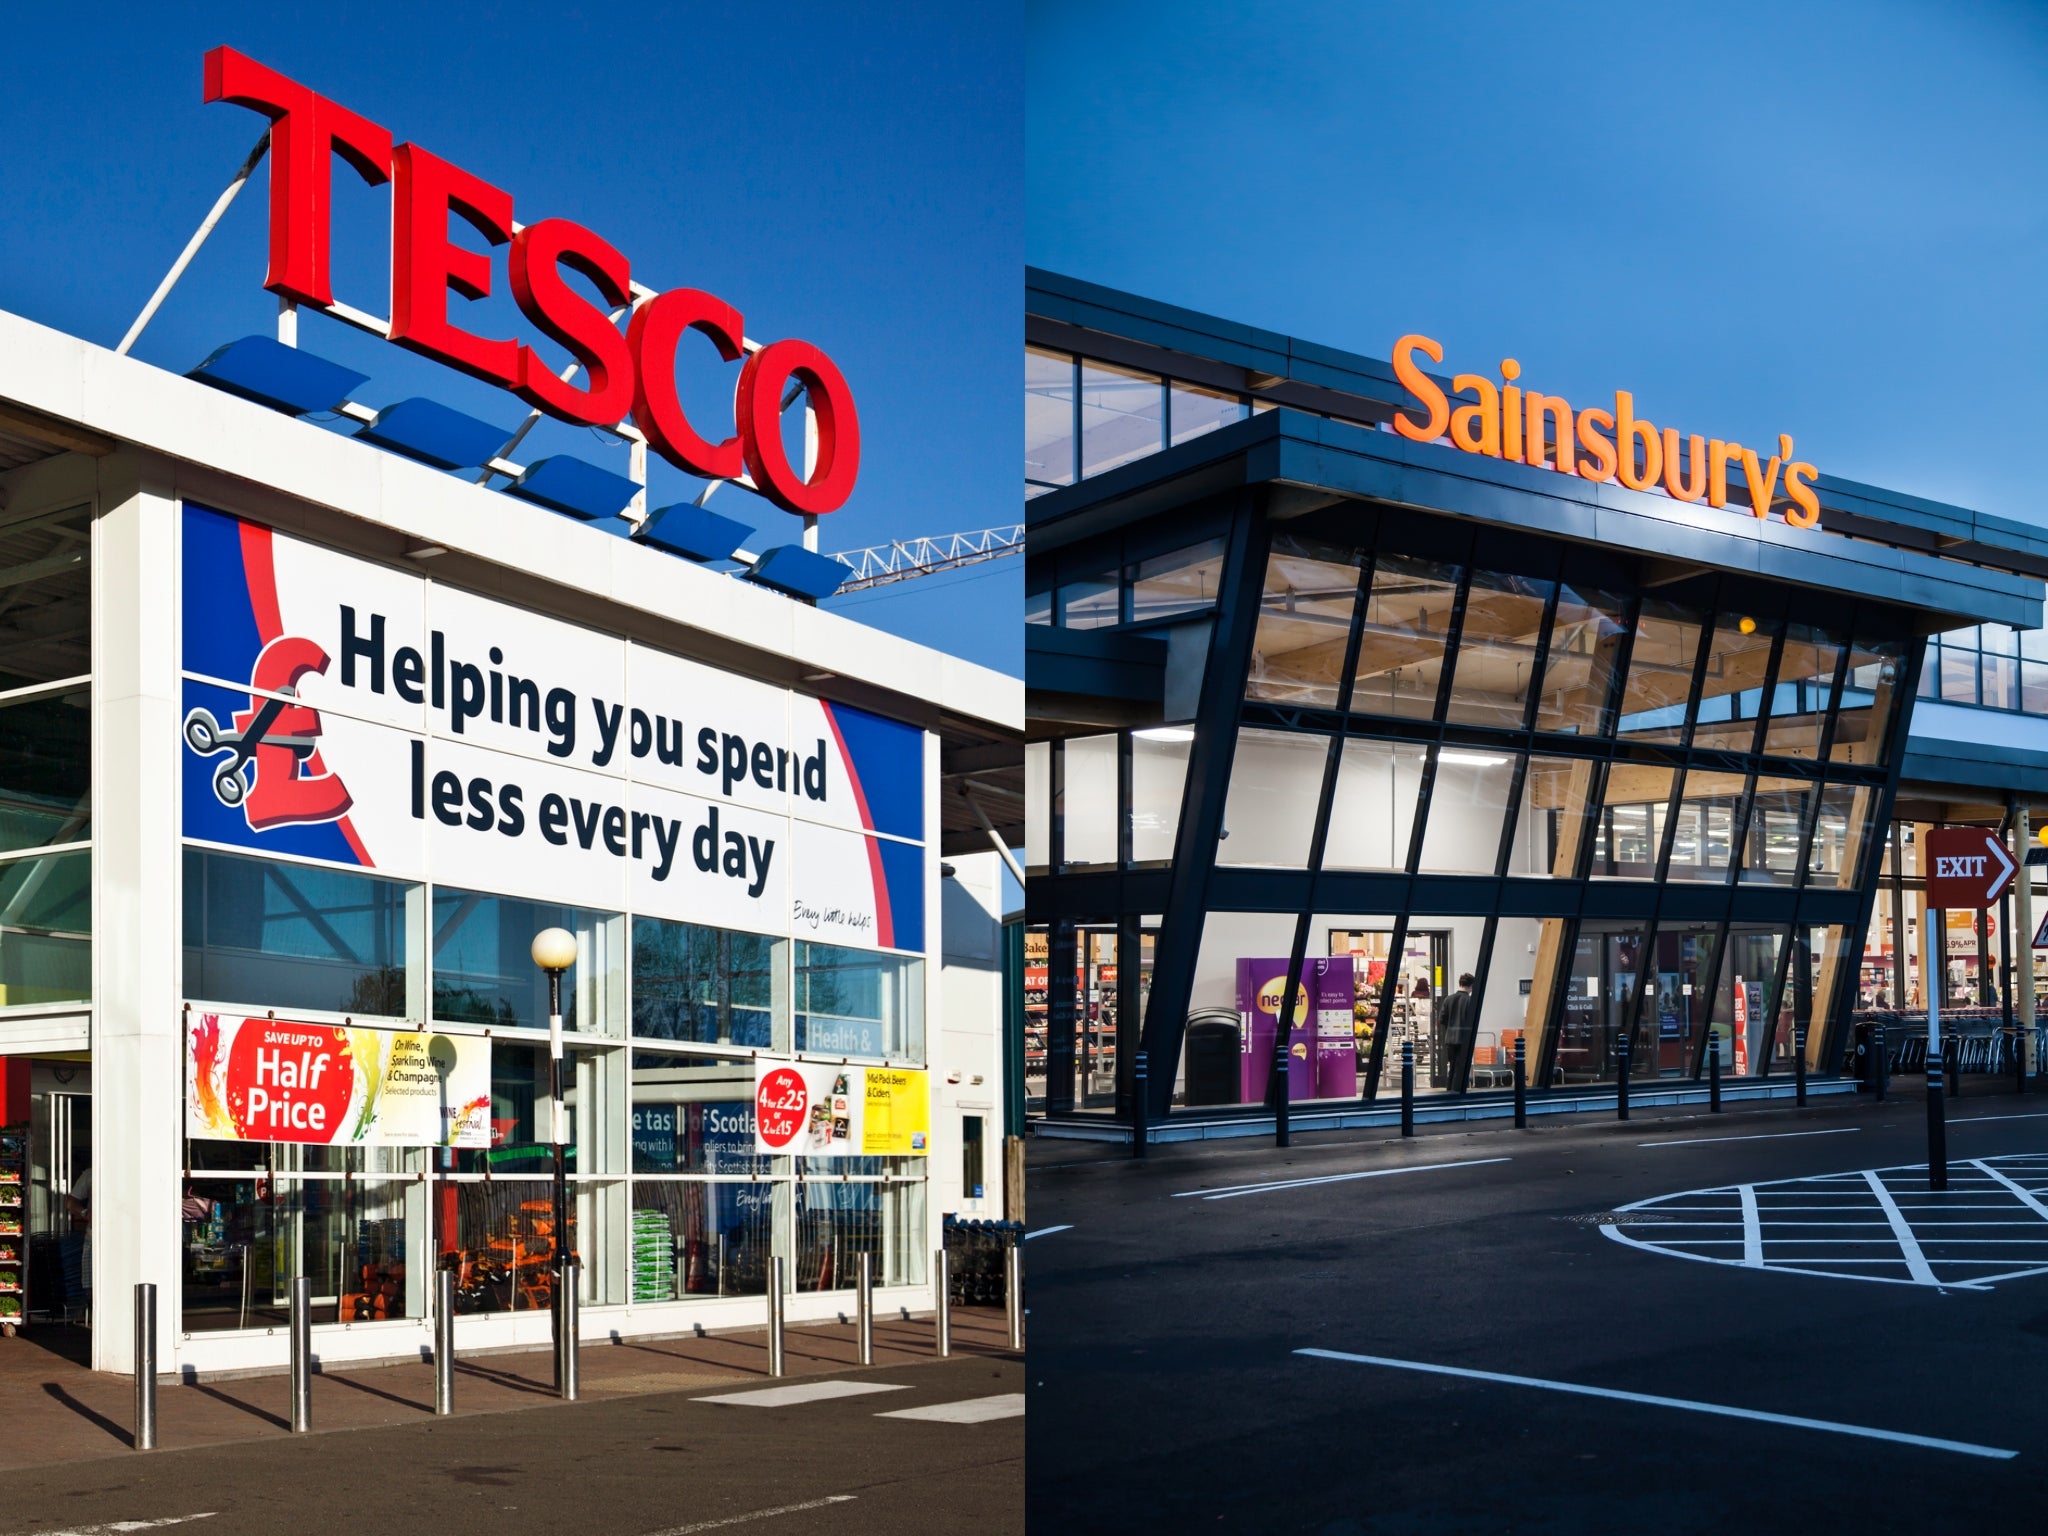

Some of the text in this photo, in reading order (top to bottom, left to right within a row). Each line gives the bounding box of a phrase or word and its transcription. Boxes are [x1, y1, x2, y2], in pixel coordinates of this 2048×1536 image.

[203, 44, 860, 515] TESCO
[1392, 334, 1820, 529] Sainsbury's
[340, 604, 828, 802] Helping you spend
[410, 739, 776, 898] less every day
[1935, 856, 1988, 878] EXIT
[794, 899, 820, 929] Every
[264, 1031, 323, 1048] SAVE UP TO
[812, 1024, 872, 1052] Health &
[257, 1047, 331, 1090] Half
[392, 1054, 446, 1069] Sparkling Wine
[387, 1070, 393, 1081] &
[775, 1075, 793, 1089] Any
[385, 1086, 437, 1096] Selected products
[759, 1086, 768, 1108] 4
[776, 1089, 806, 1112] £25
[246, 1087, 326, 1130] Price
[439, 1106, 457, 1119] WINE
[773, 1111, 782, 1119] or
[763, 1118, 770, 1135] 2
[775, 1119, 793, 1136] £15
[648, 1138, 669, 1152] with
[728, 1141, 737, 1154] to
